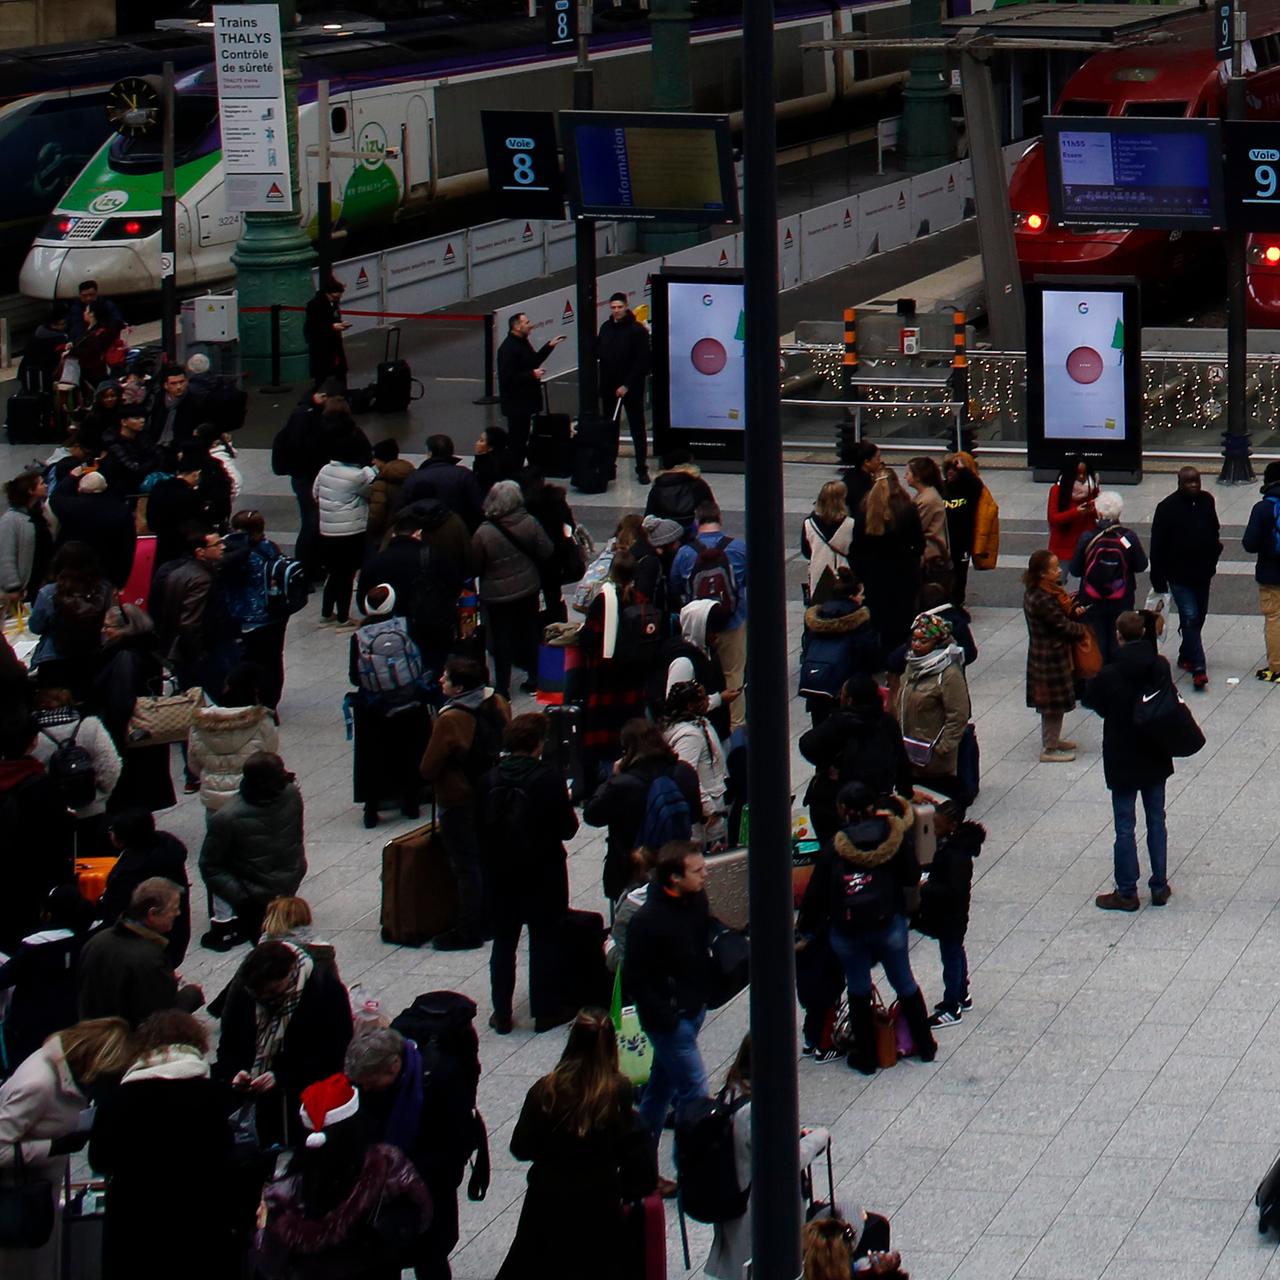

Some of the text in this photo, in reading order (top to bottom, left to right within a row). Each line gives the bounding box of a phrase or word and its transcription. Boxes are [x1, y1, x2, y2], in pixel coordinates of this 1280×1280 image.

[219, 17, 258, 28] Trains
[557, 12, 567, 38] 8
[220, 32, 272, 44] THALYS
[1221, 19, 1229, 46] 9
[221, 49, 269, 60] Contrôle
[222, 62, 274, 72] de sûreté
[509, 138, 531, 148] Voie
[1253, 150, 1276, 160] Voie
[512, 153, 536, 185] 8
[615, 128, 633, 207] information
[1254, 165, 1278, 198] 9
[702, 294, 713, 306] G
[1078, 302, 1088, 315] G
